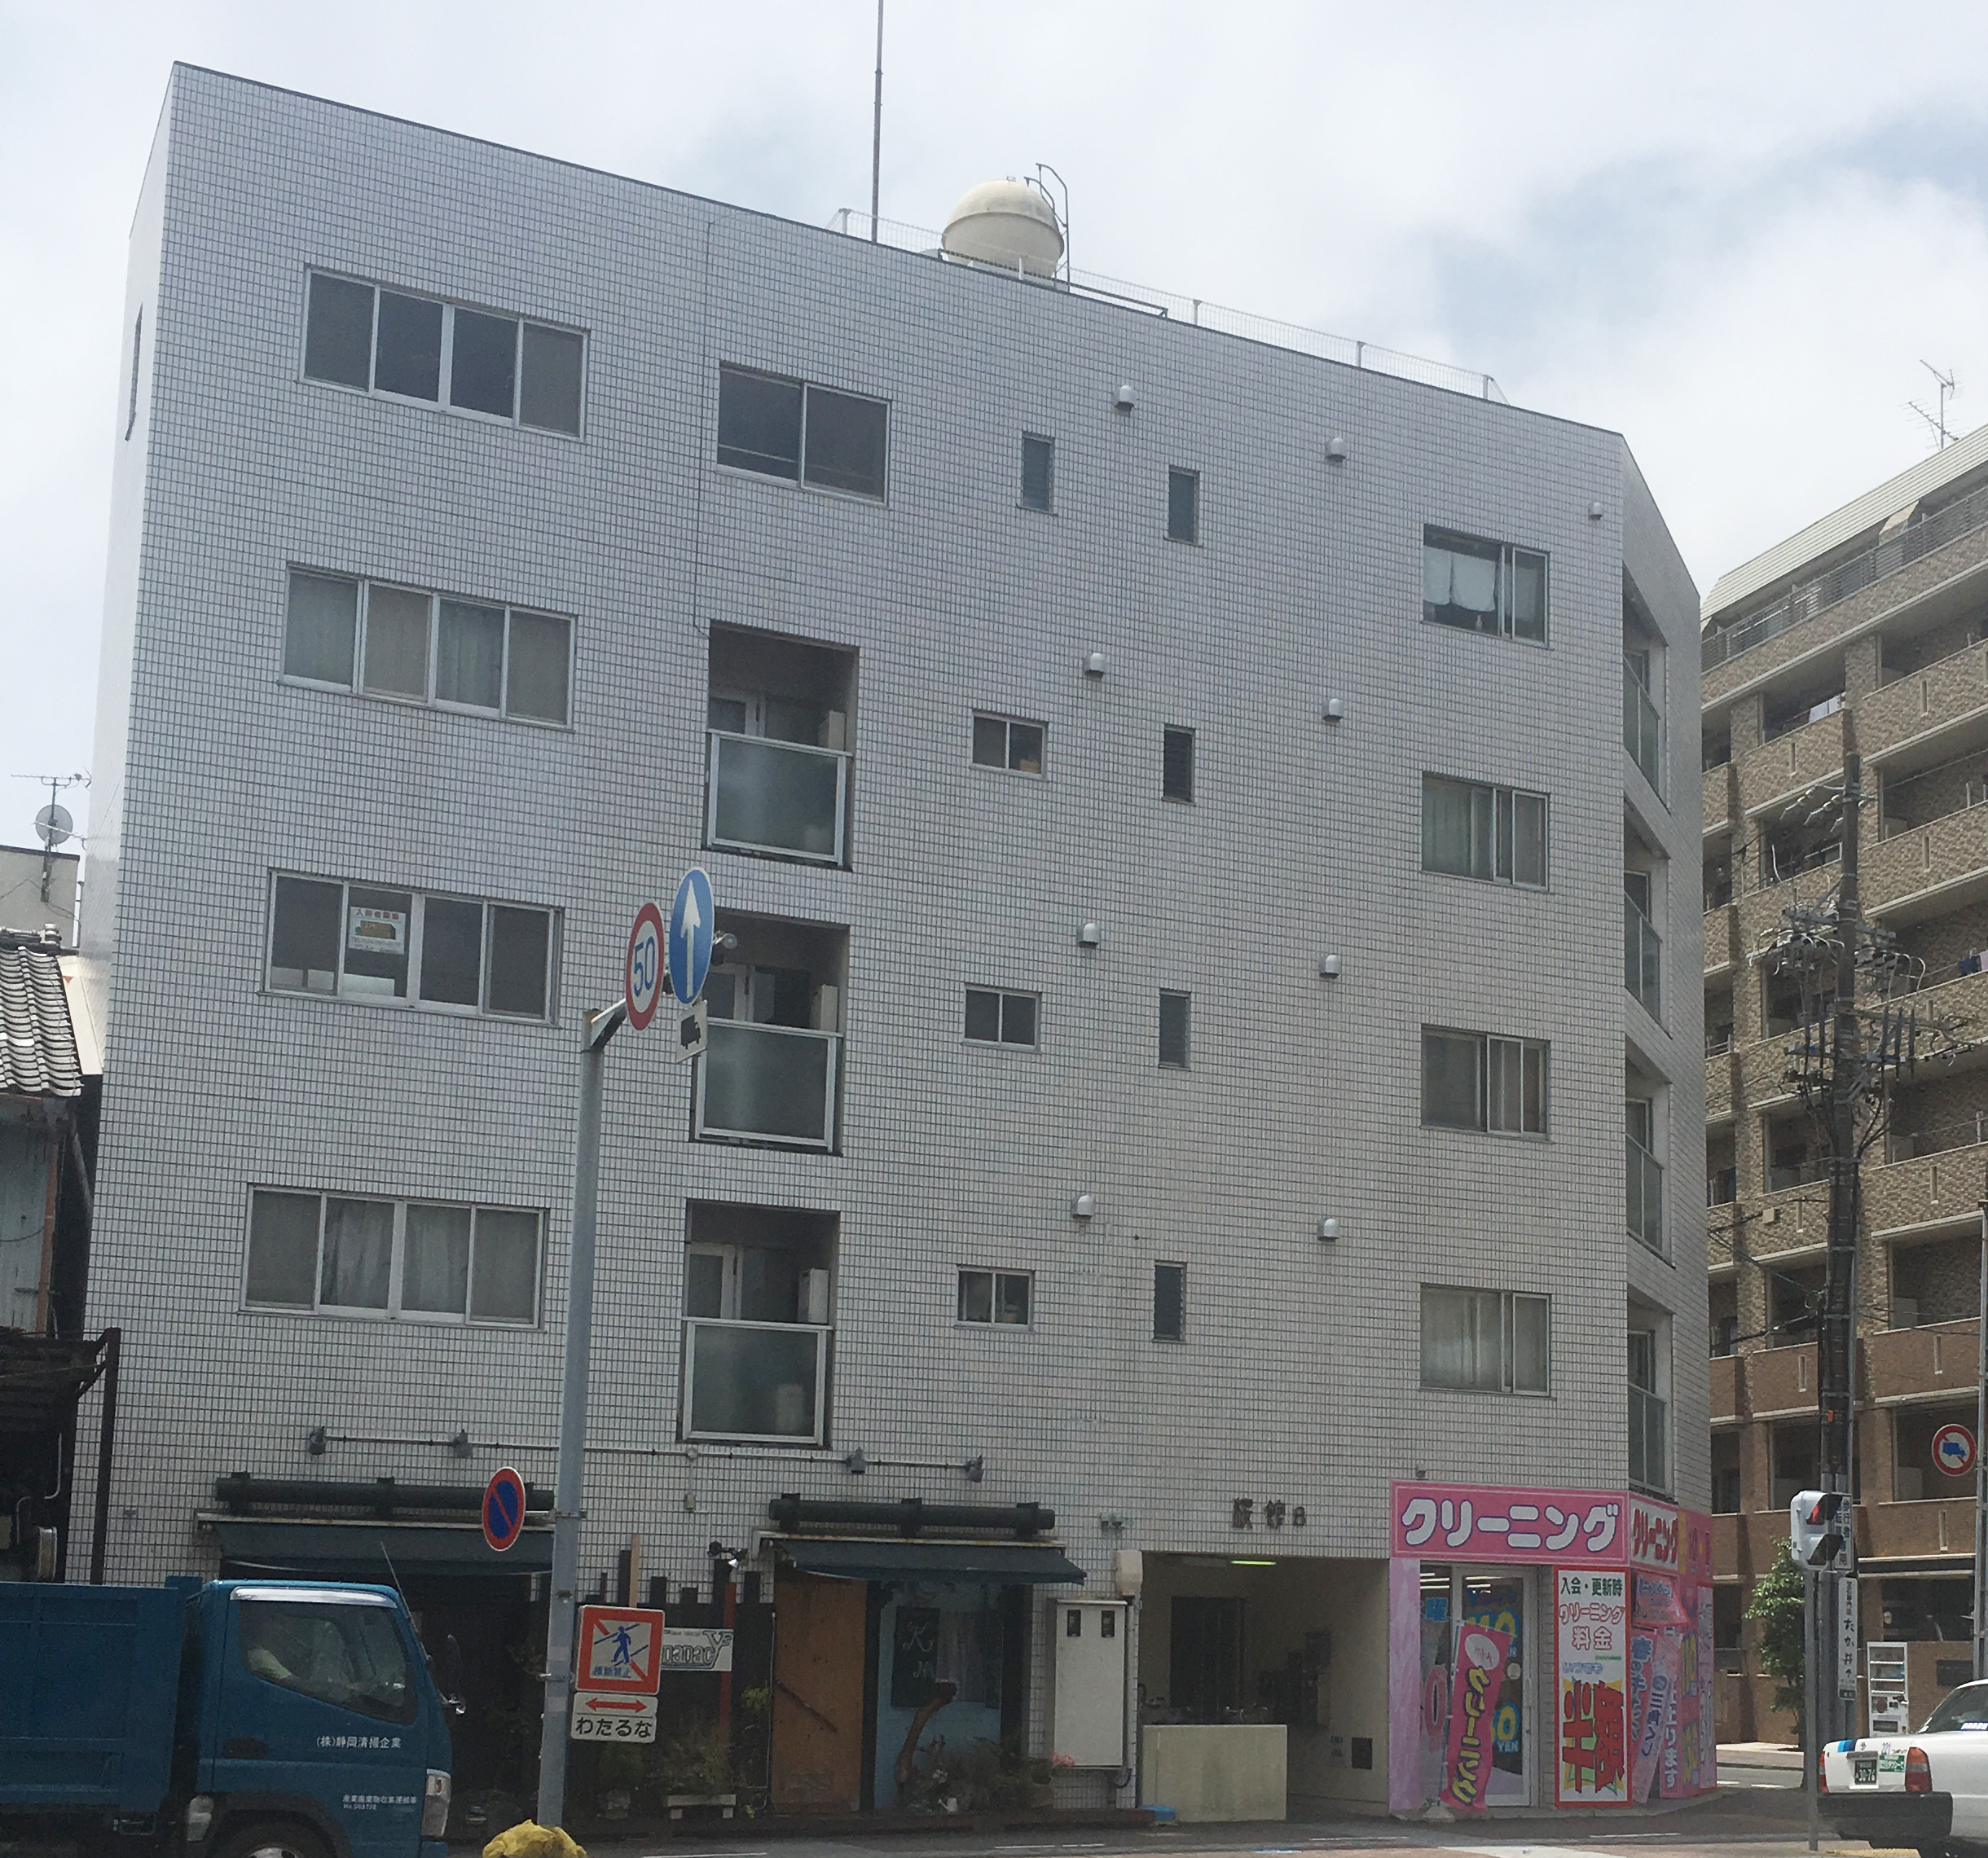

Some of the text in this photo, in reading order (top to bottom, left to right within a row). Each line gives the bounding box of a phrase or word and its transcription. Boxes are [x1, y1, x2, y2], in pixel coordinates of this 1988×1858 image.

[632, 936, 656, 998] 50
[1401, 1497, 1620, 1552] クリーニング
[1560, 1577, 1623, 1597] 入会・更新時
[1559, 1601, 1627, 1625] クリーニング
[1572, 1626, 1612, 1651] 料金
[575, 1716, 652, 1738] わたるな
[1450, 1666, 1491, 1806] クリーニング
[1562, 1679, 1625, 1794] 半額
